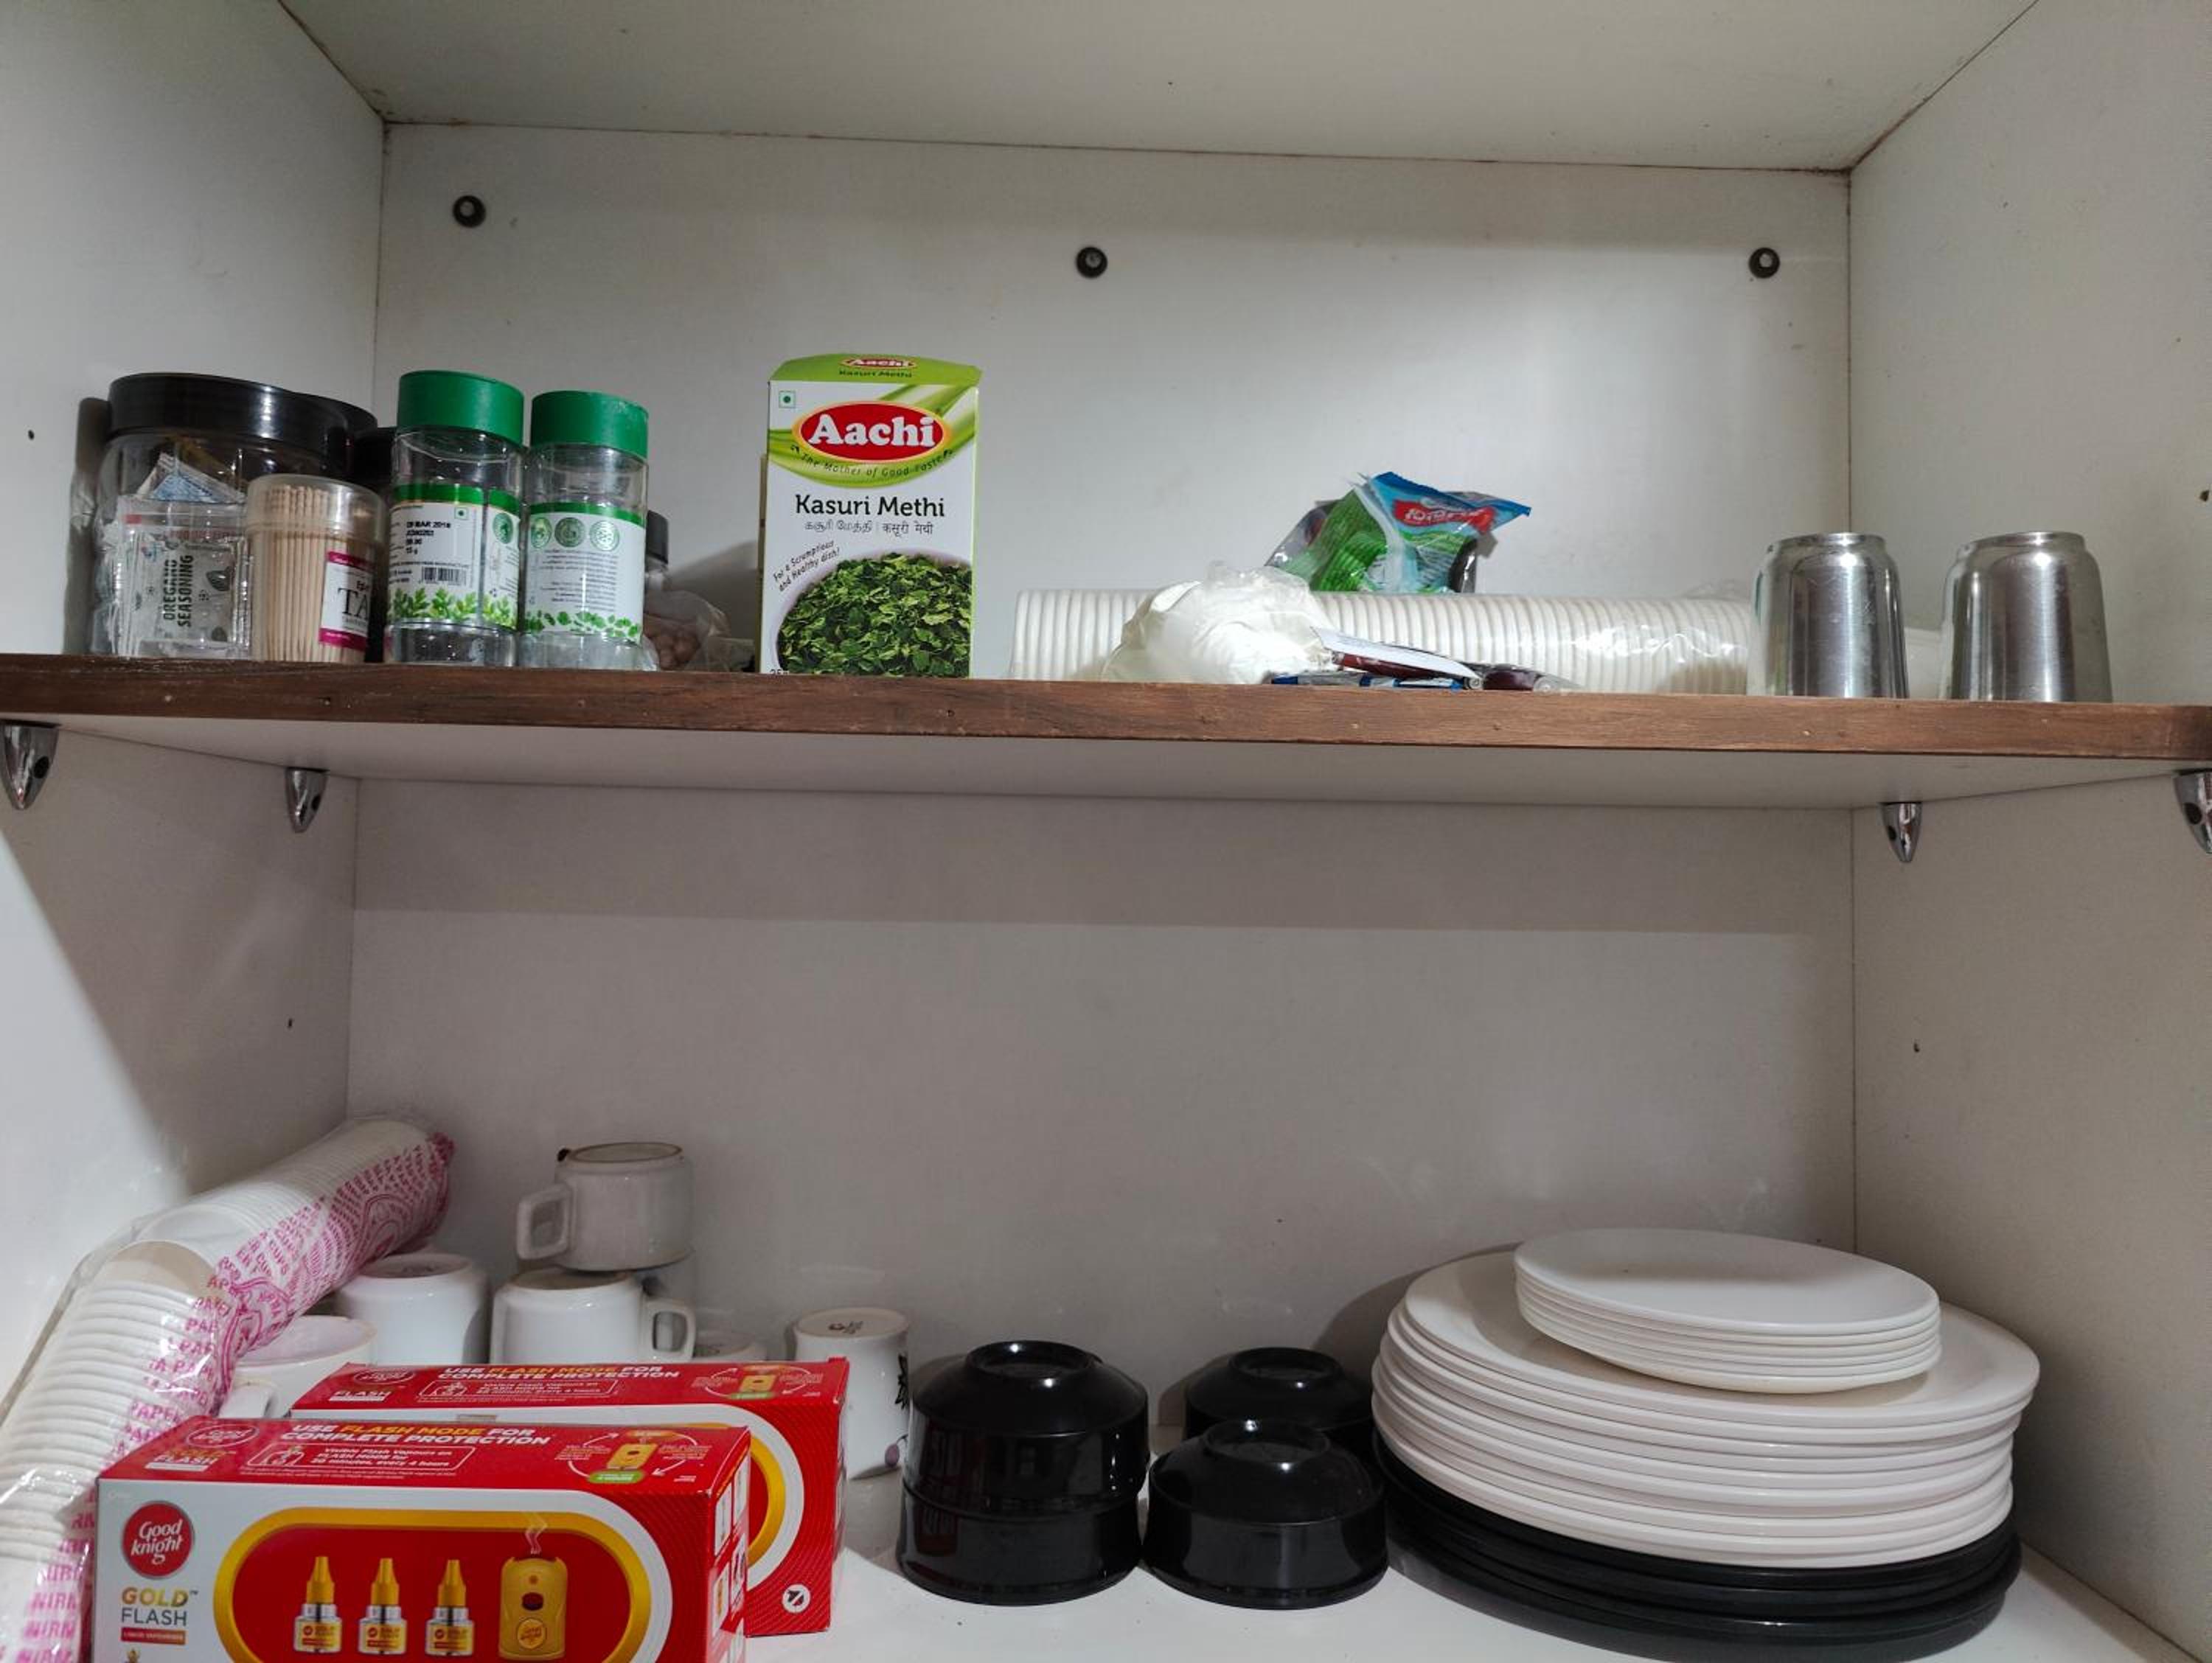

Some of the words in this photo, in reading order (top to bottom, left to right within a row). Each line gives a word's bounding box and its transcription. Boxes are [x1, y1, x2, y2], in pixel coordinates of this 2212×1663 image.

[849, 358, 909, 367] Aachi
[808, 413, 937, 447] Aachi
[801, 453, 818, 467] The
[824, 462, 861, 475] Mother
[866, 467, 878, 478] of
[881, 467, 910, 478] Good
[795, 495, 870, 515] Kasuri
[877, 496, 945, 517] Methi
[163, 559, 177, 621] OREGANO
[177, 554, 194, 628] SEASONING
[281, 1432, 403, 1443] COMPLETE
[403, 1434, 552, 1445] PROTECTION
[340, 1425, 416, 1434] FLASH
[416, 1426, 485, 1436] MODE
[487, 1428, 536, 1437] FOR
[139, 1519, 184, 1541] Good
[131, 1535, 184, 1566] knight
[122, 1586, 189, 1608] GOLD
[121, 1607, 187, 1626] FLASH
